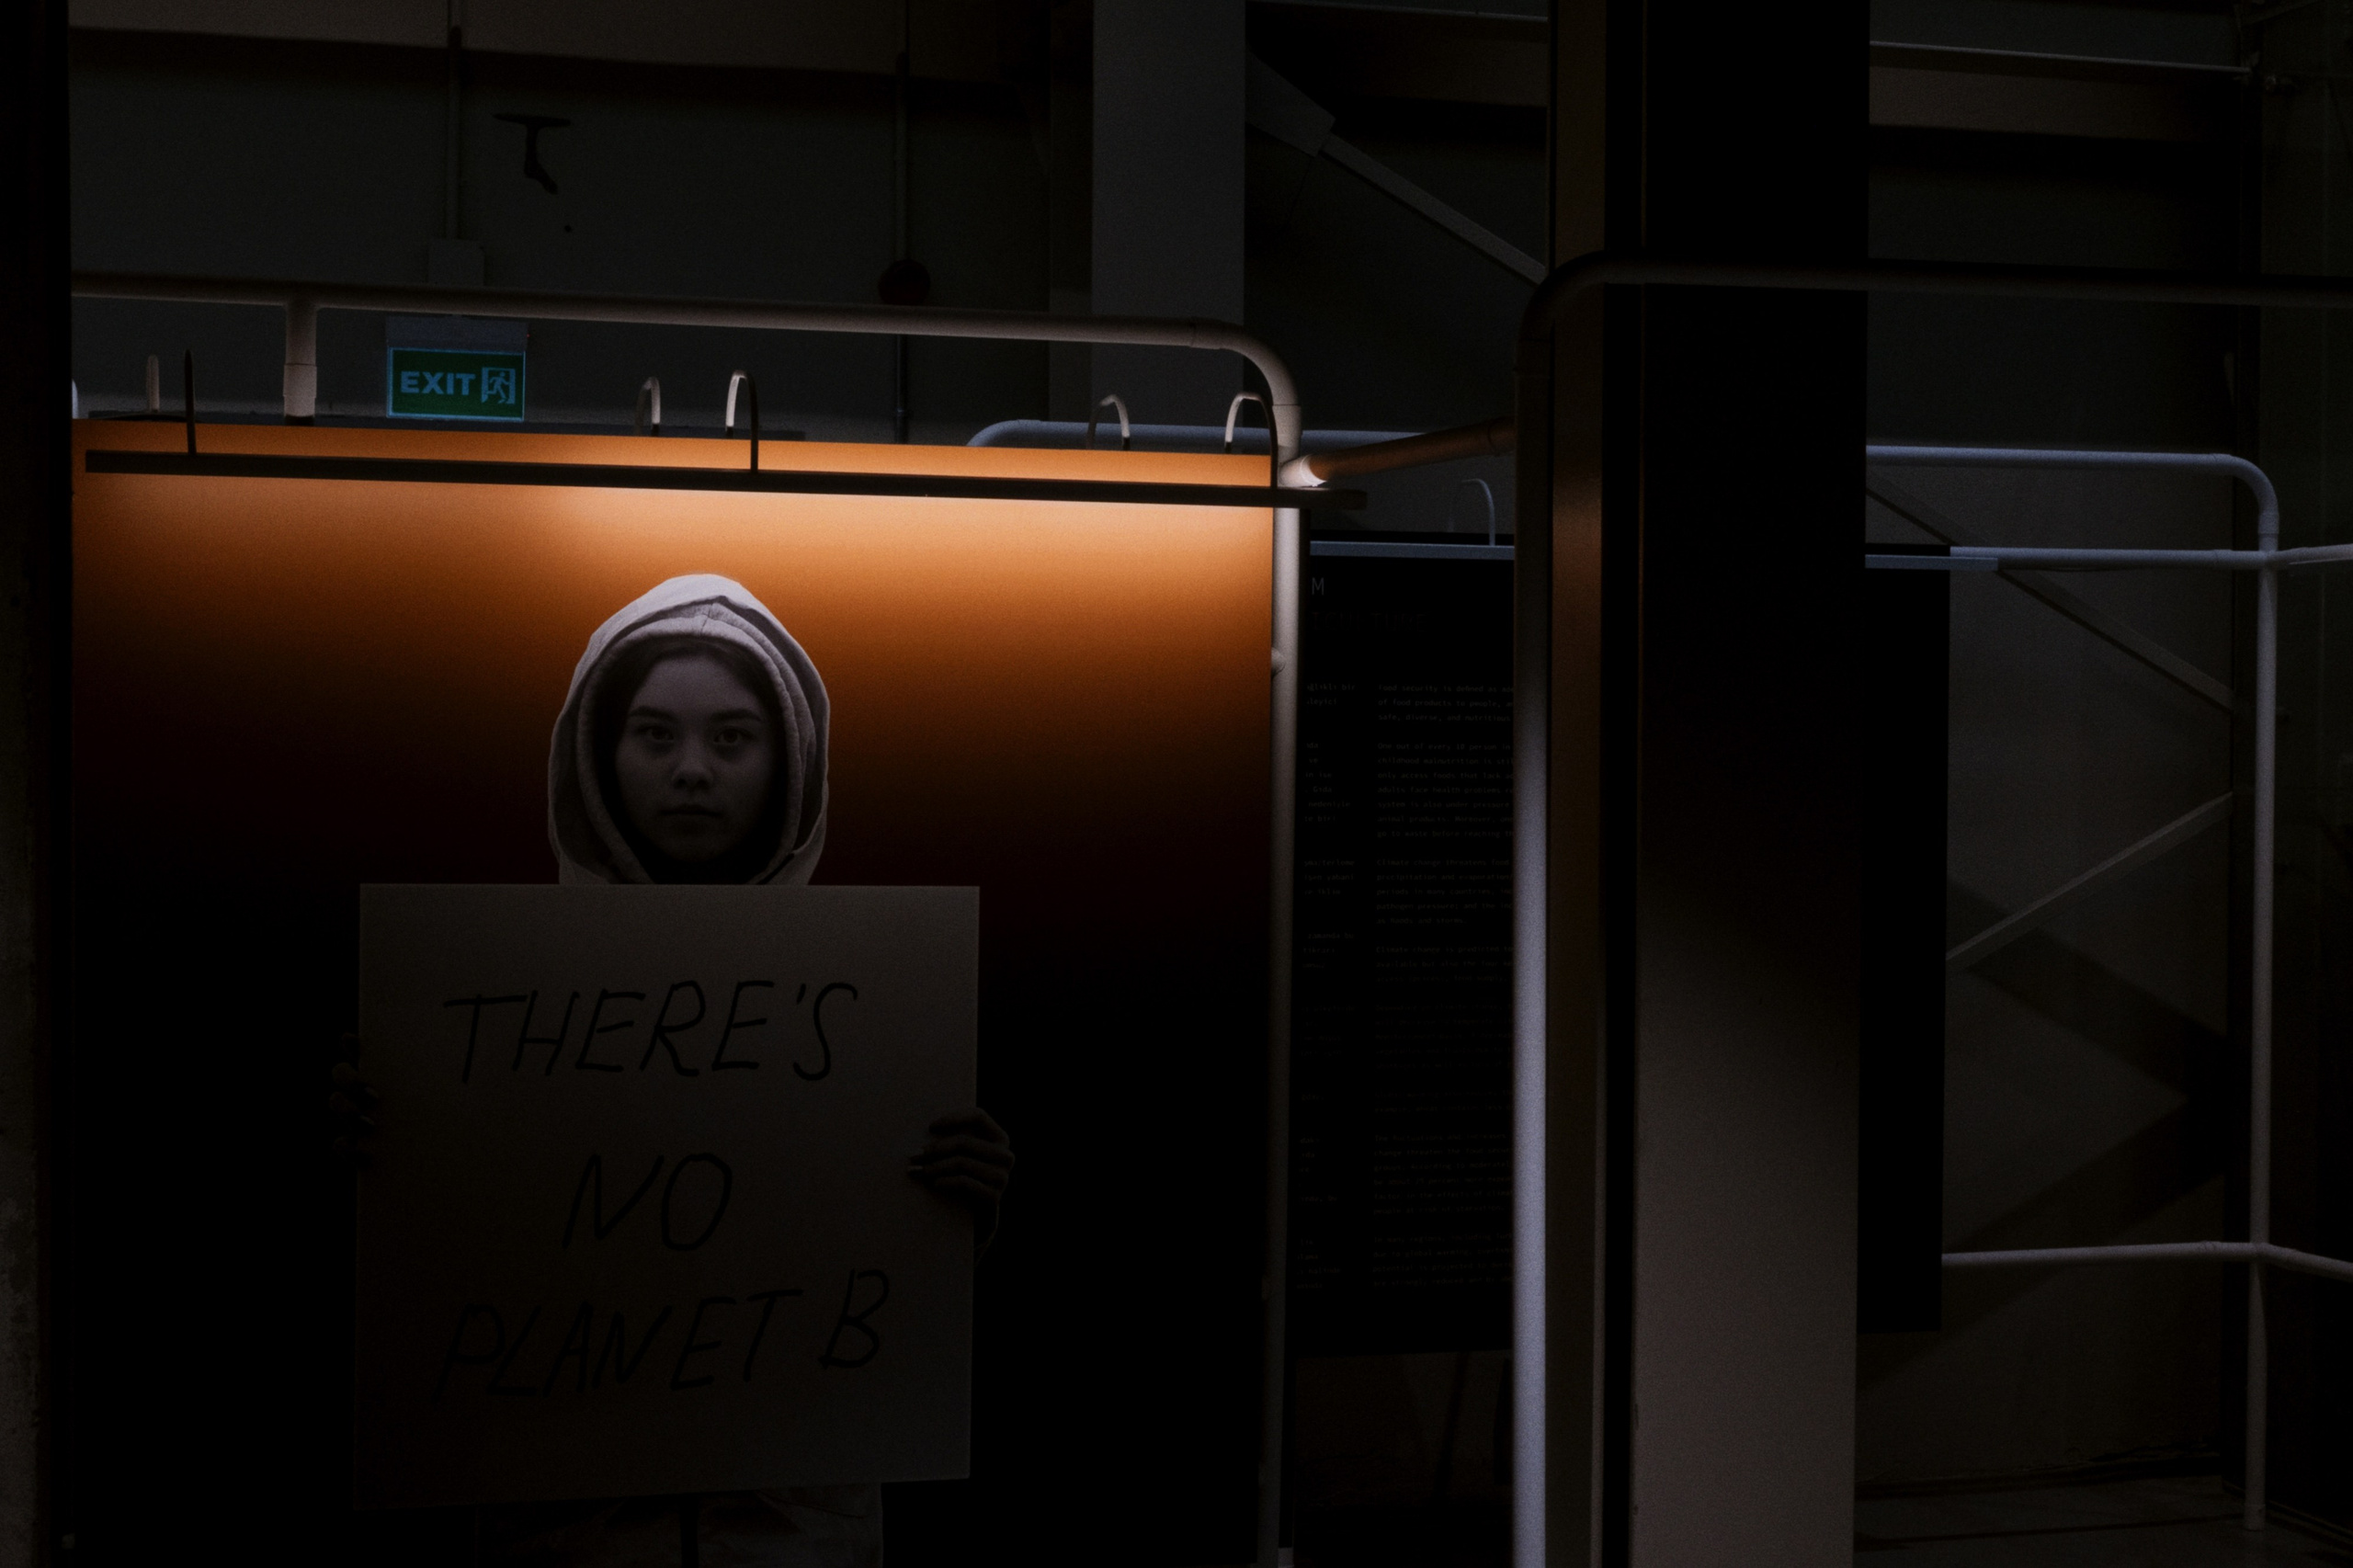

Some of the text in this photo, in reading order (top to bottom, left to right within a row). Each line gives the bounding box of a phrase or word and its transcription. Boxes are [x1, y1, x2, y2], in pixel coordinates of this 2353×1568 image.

[400, 369, 476, 396] EXIT
[444, 980, 858, 1084] THERE'S
[562, 1153, 733, 1251] NO
[431, 1268, 890, 1403] PLANET B
